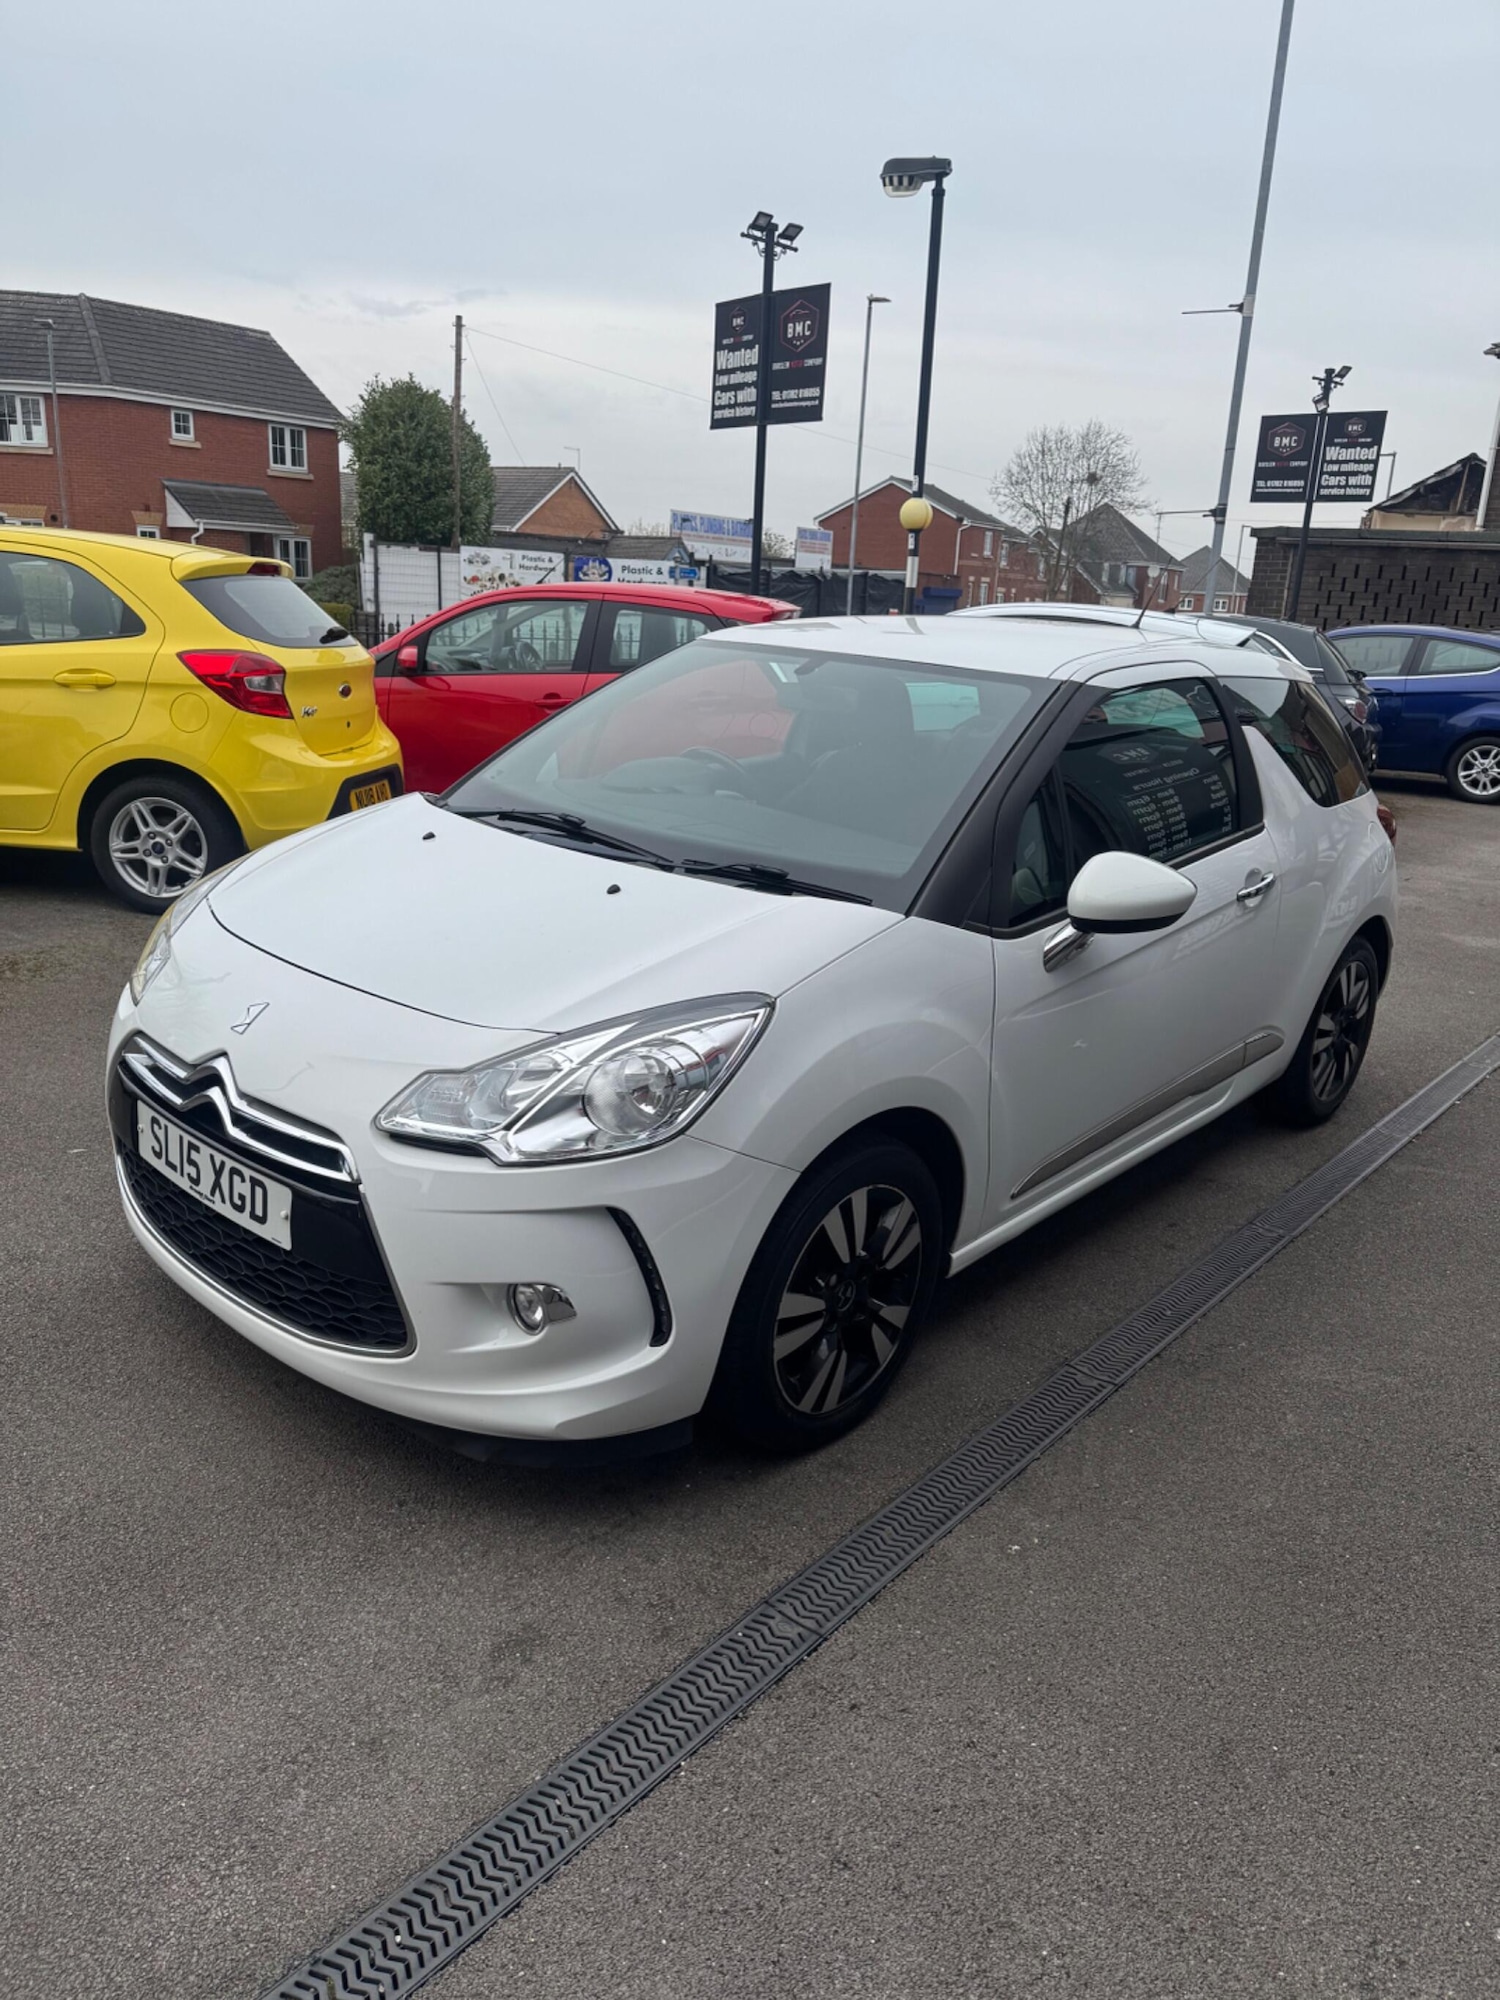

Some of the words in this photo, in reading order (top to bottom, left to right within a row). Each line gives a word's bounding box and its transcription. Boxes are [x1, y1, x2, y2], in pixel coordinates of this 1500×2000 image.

[787, 320, 812, 338] BMC
[716, 345, 759, 370] Wanted
[715, 374, 729, 386] Low
[729, 370, 758, 384] mileage
[714, 390, 735, 406] Cars
[736, 386, 757, 404] with
[713, 408, 735, 419] service
[735, 406, 756, 418] history
[1274, 436, 1298, 447] BMC
[1325, 445, 1378, 460] Wanted
[1323, 463, 1339, 472] Low
[1340, 462, 1375, 473] mileage
[1321, 474, 1347, 486] Cars
[1348, 474, 1373, 486] with
[1319, 487, 1345, 496] service
[1345, 486, 1371, 496] history
[521, 554, 546, 563] Plastic
[621, 565, 653, 575] Plastic
[656, 567, 663, 575] &
[151, 1115, 201, 1187] SL15
[209, 1153, 268, 1225] XGD
